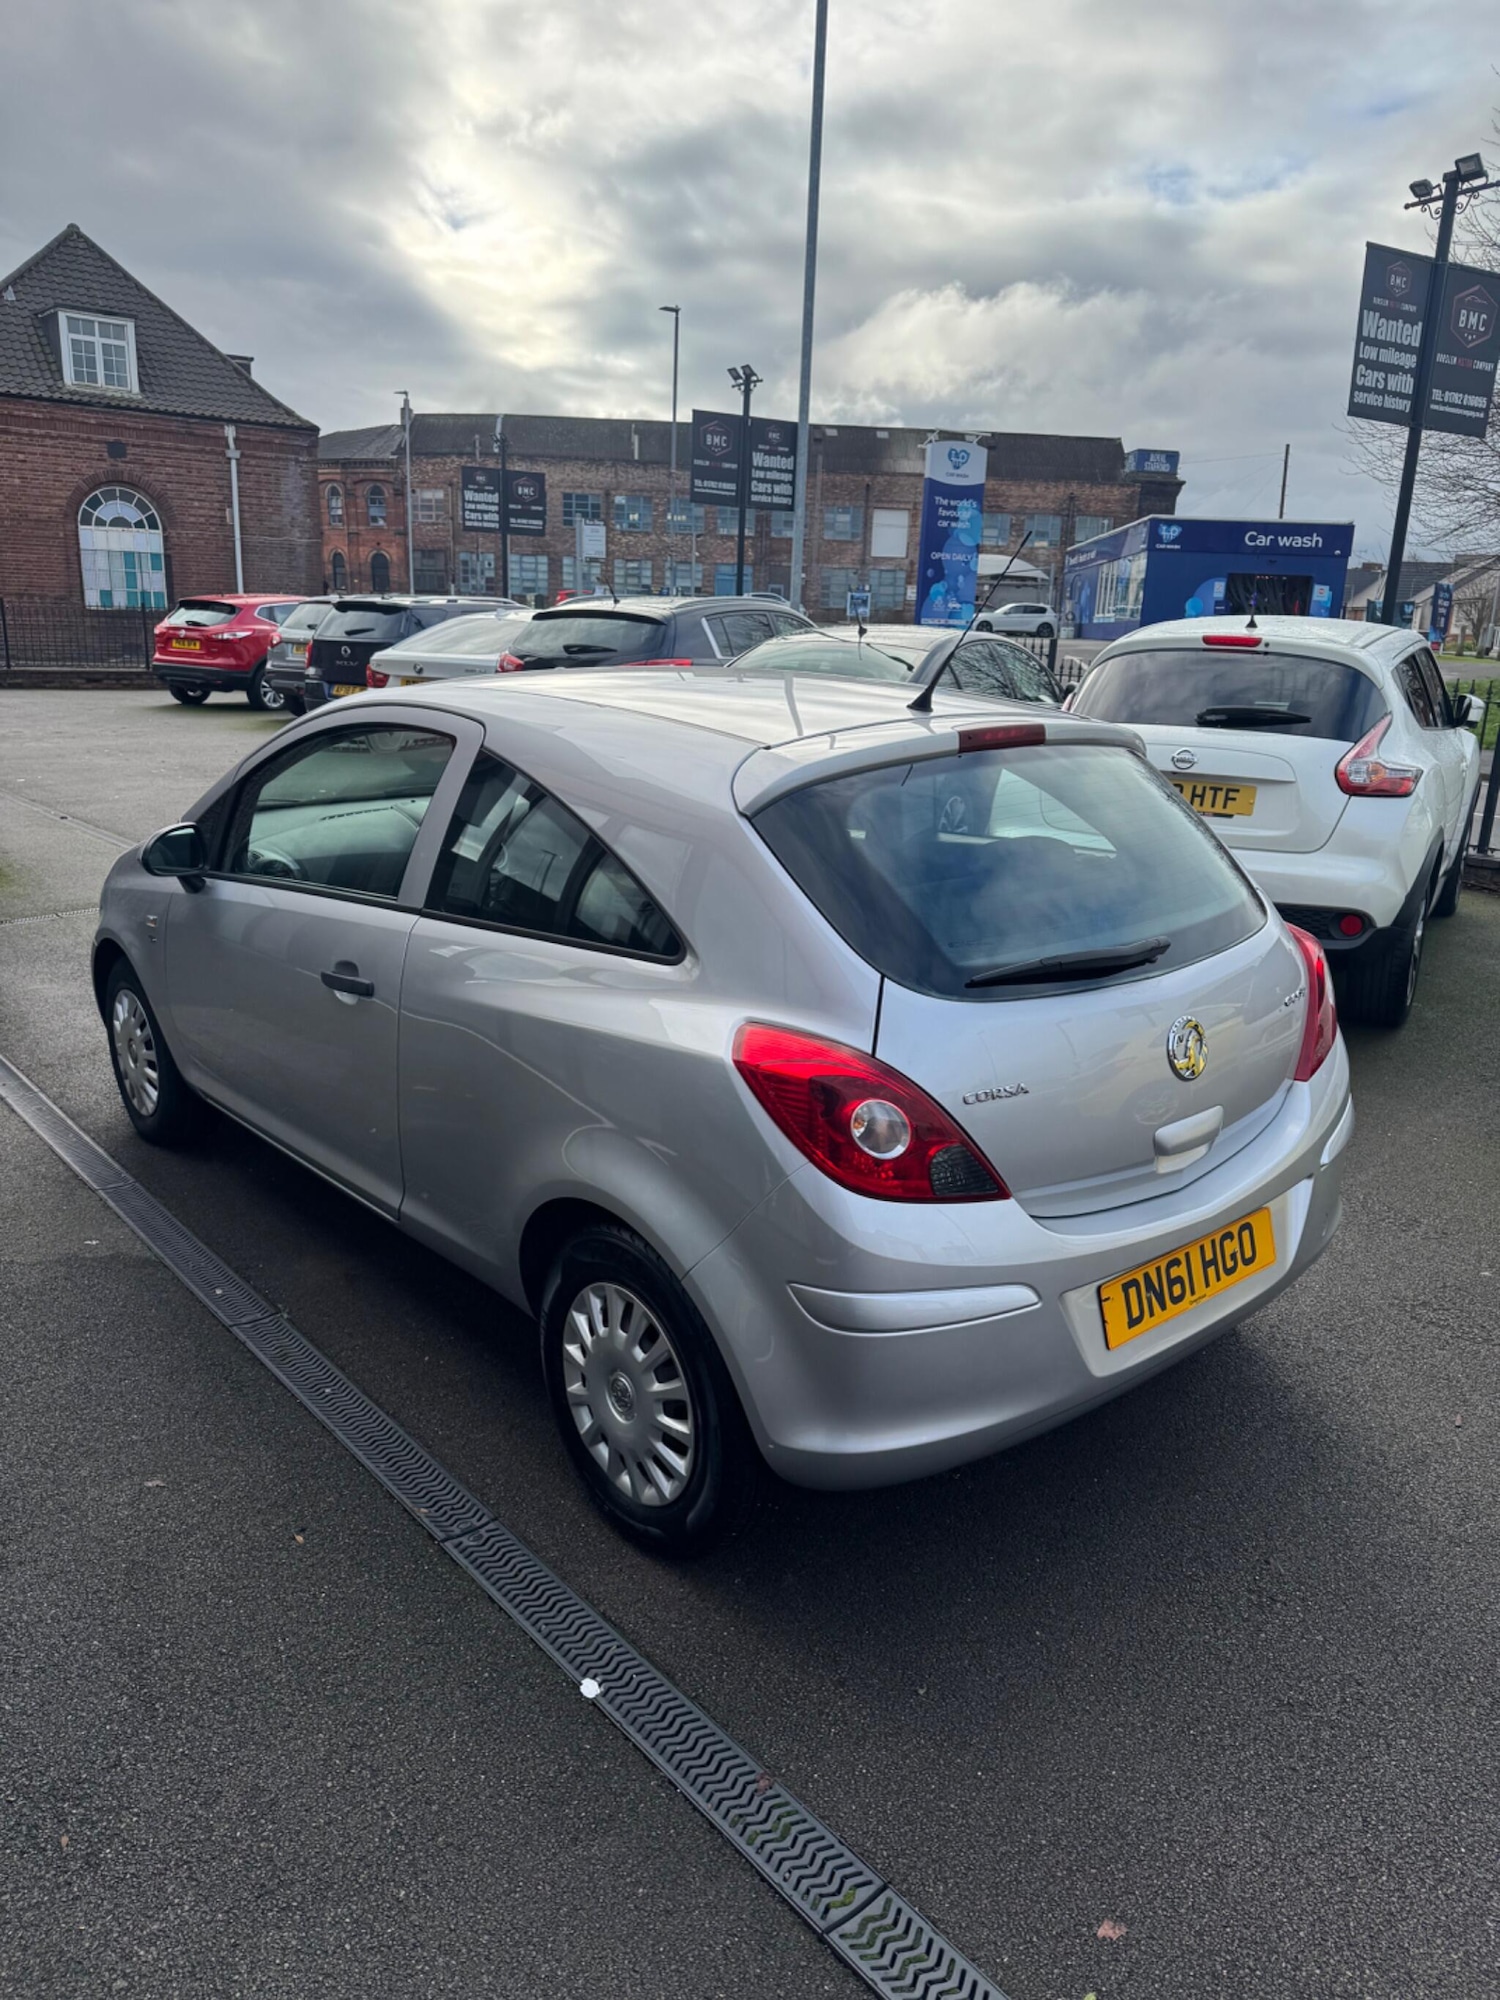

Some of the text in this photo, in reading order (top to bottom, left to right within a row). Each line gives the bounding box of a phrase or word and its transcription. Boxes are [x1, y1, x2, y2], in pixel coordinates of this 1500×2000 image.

[1390, 274, 1407, 288] BMC
[1362, 309, 1423, 347] Wanted
[1459, 309, 1488, 331] BMC
[1359, 341, 1417, 369] Low mileage
[1356, 364, 1414, 395] Cars with
[1353, 390, 1383, 407] service
[1383, 394, 1412, 413] history
[706, 433, 727, 447] BMC
[752, 451, 794, 470] Wanted
[751, 468, 793, 482] Low mileage
[517, 486, 535, 496] BMC
[751, 480, 772, 493] Cars
[772, 482, 793, 496] with
[464, 489, 499, 504] Wanted
[751, 494, 792, 505] service history
[934, 495, 977, 508] The world's
[464, 510, 482, 520] Cars
[937, 519, 971, 529] car wash
[1244, 531, 1323, 548] Car wash
[930, 551, 972, 562] OPEN DAILY
[1190, 784, 1240, 809] HTF
[963, 1083, 1030, 1105] CORSA
[1121, 1221, 1257, 1330] DN61 HGO
